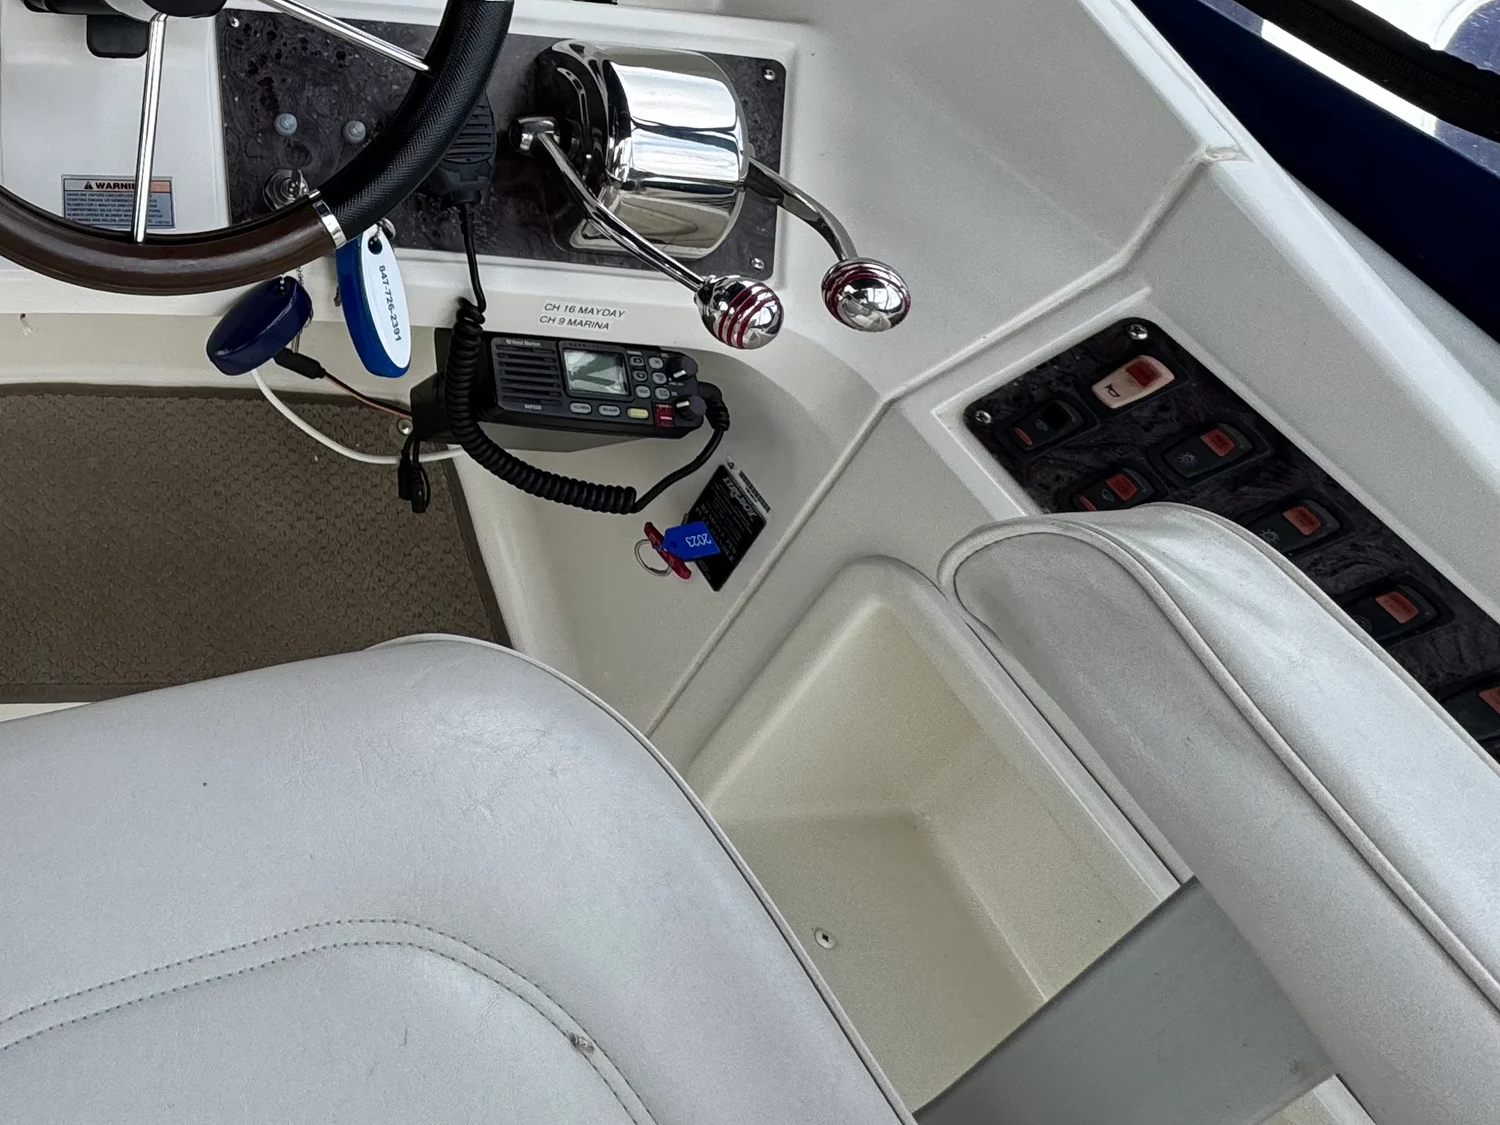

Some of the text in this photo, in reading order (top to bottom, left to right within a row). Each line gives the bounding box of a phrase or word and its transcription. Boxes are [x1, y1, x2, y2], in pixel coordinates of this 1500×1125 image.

[95, 181, 135, 190] WARNI
[379, 265, 402, 342] 847-726-2391
[544, 303, 625, 318] CH 16 MAYDAY
[540, 316, 556, 324] CH
[567, 318, 609, 330] MARINA
[685, 532, 712, 548] 2023
